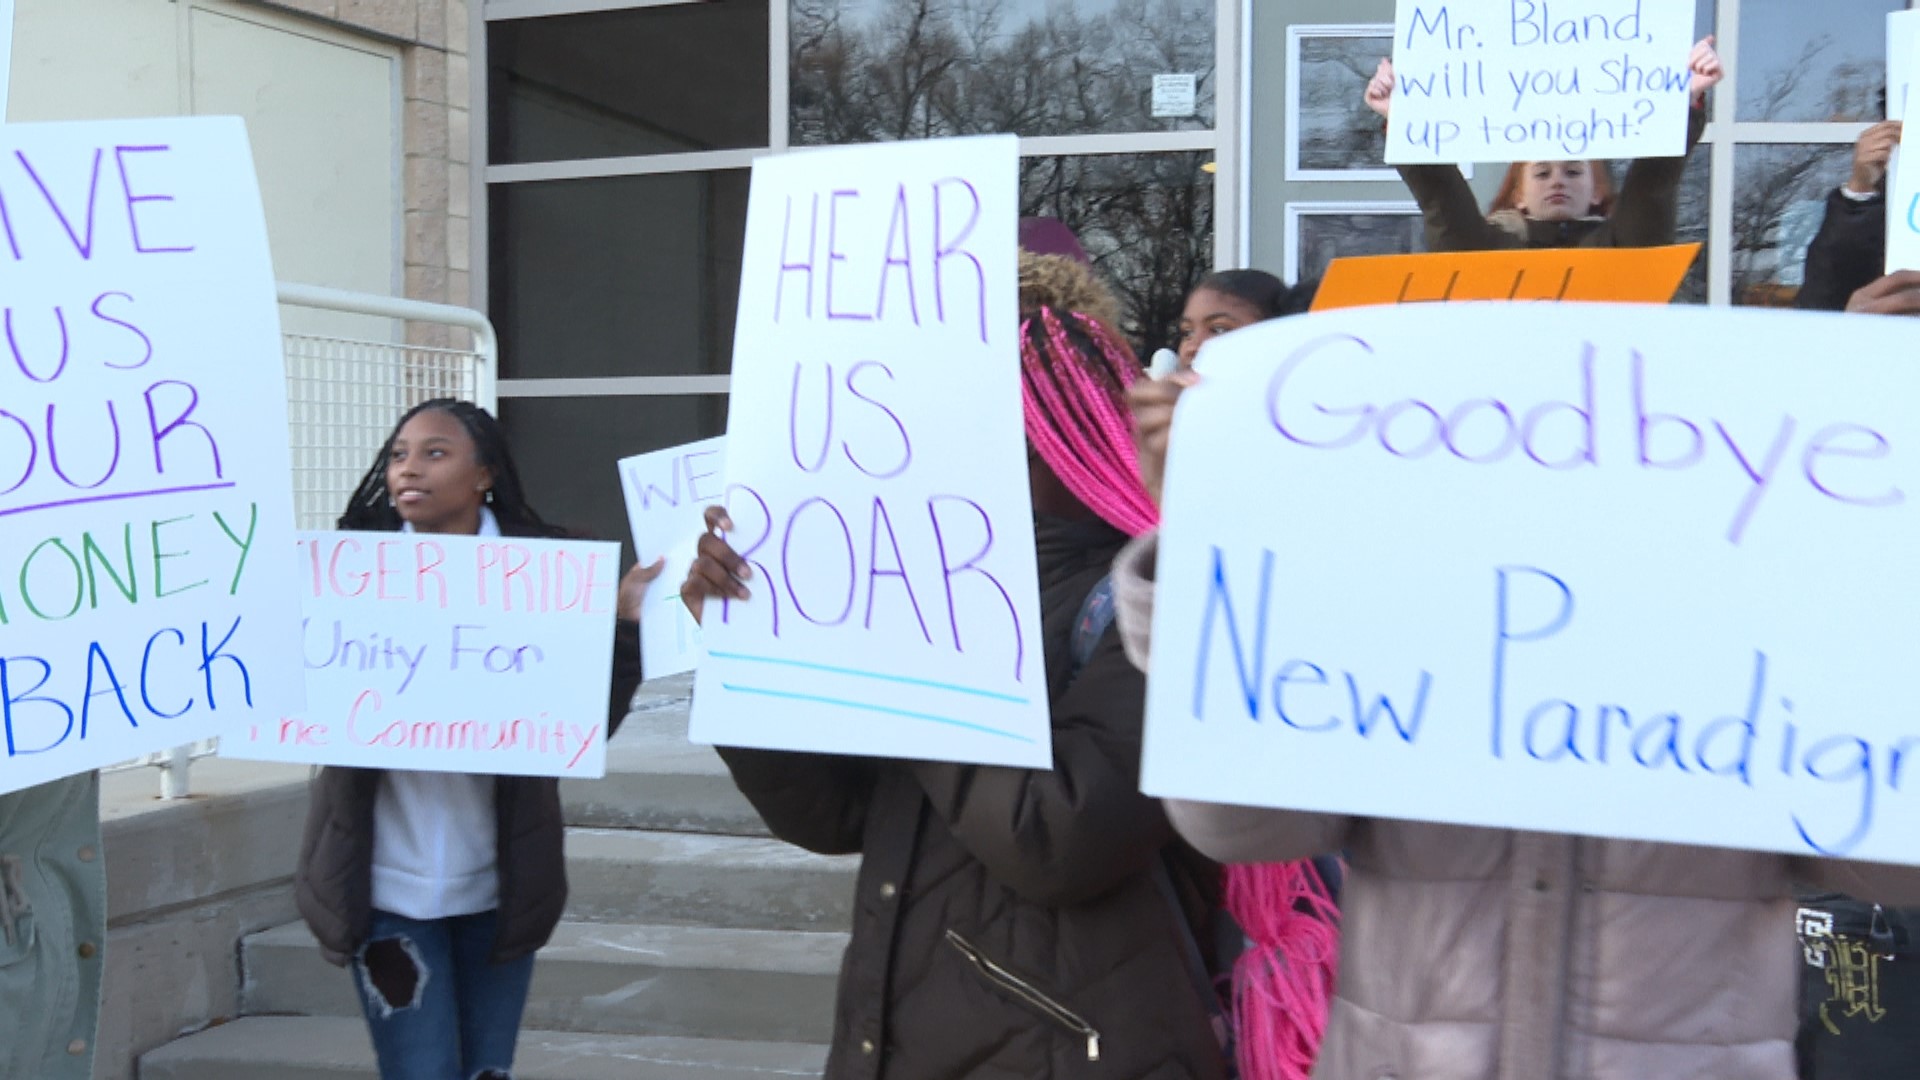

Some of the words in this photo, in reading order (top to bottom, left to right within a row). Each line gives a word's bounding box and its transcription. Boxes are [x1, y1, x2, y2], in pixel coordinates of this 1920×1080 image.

[1406, 5, 1484, 50] Mr.
[1511, 0, 1653, 46] Bland,
[1400, 60, 1485, 98] will
[1509, 66, 1581, 112] you
[1406, 119, 1460, 156] up
[1478, 99, 1655, 155] tonight?
[775, 177, 988, 345] HEAR
[4, 290, 153, 383] US
[789, 361, 911, 479] US
[628, 450, 724, 510] WE
[0, 502, 257, 624] ONEY
[297, 538, 448, 608] IGER
[476, 543, 611, 613] PRIDE
[722, 483, 1022, 683] ROAR
[0, 615, 253, 757] BACK
[302, 616, 427, 695] Unity
[451, 623, 544, 674] For
[1191, 544, 1432, 745] New
[347, 689, 601, 769] Community
